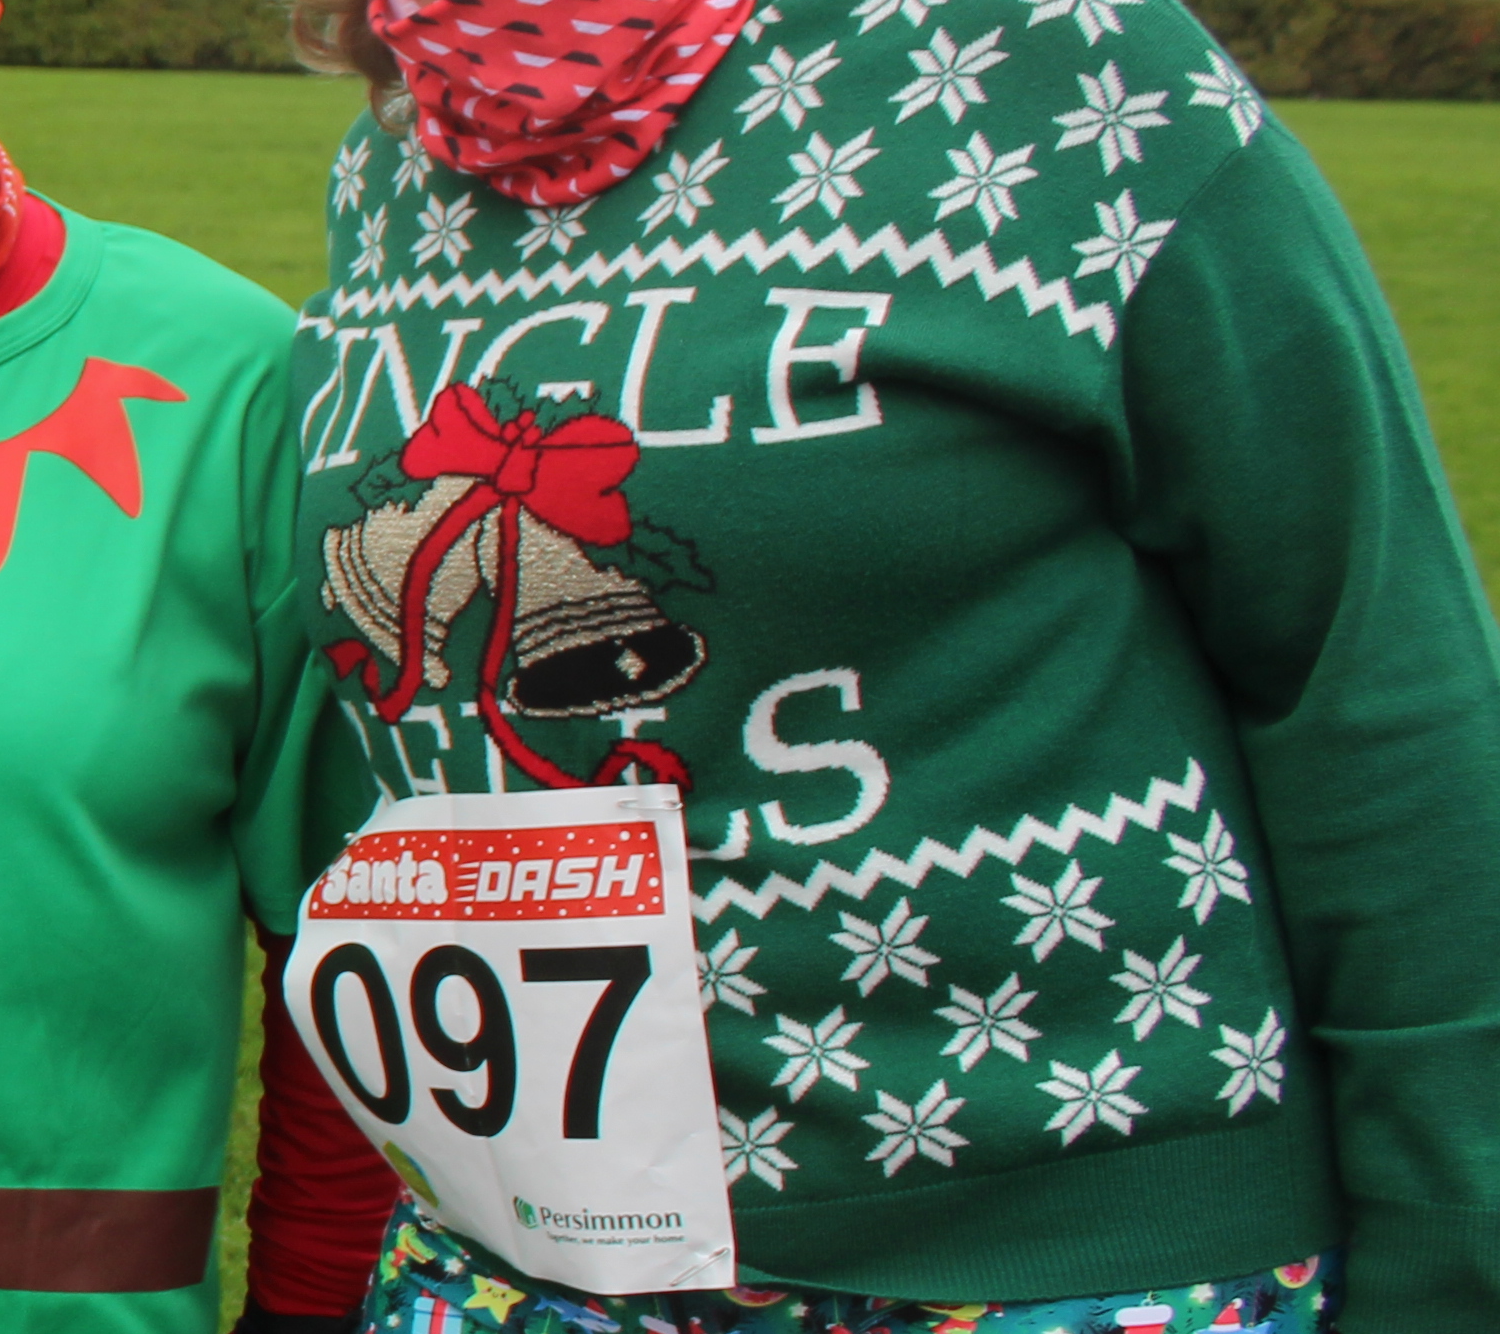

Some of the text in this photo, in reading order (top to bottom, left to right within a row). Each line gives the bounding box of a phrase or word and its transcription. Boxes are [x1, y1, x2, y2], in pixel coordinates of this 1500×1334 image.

[321, 850, 644, 906] Santa DASH
[311, 942, 653, 1141] 097
[539, 1206, 683, 1230] Persimmon
